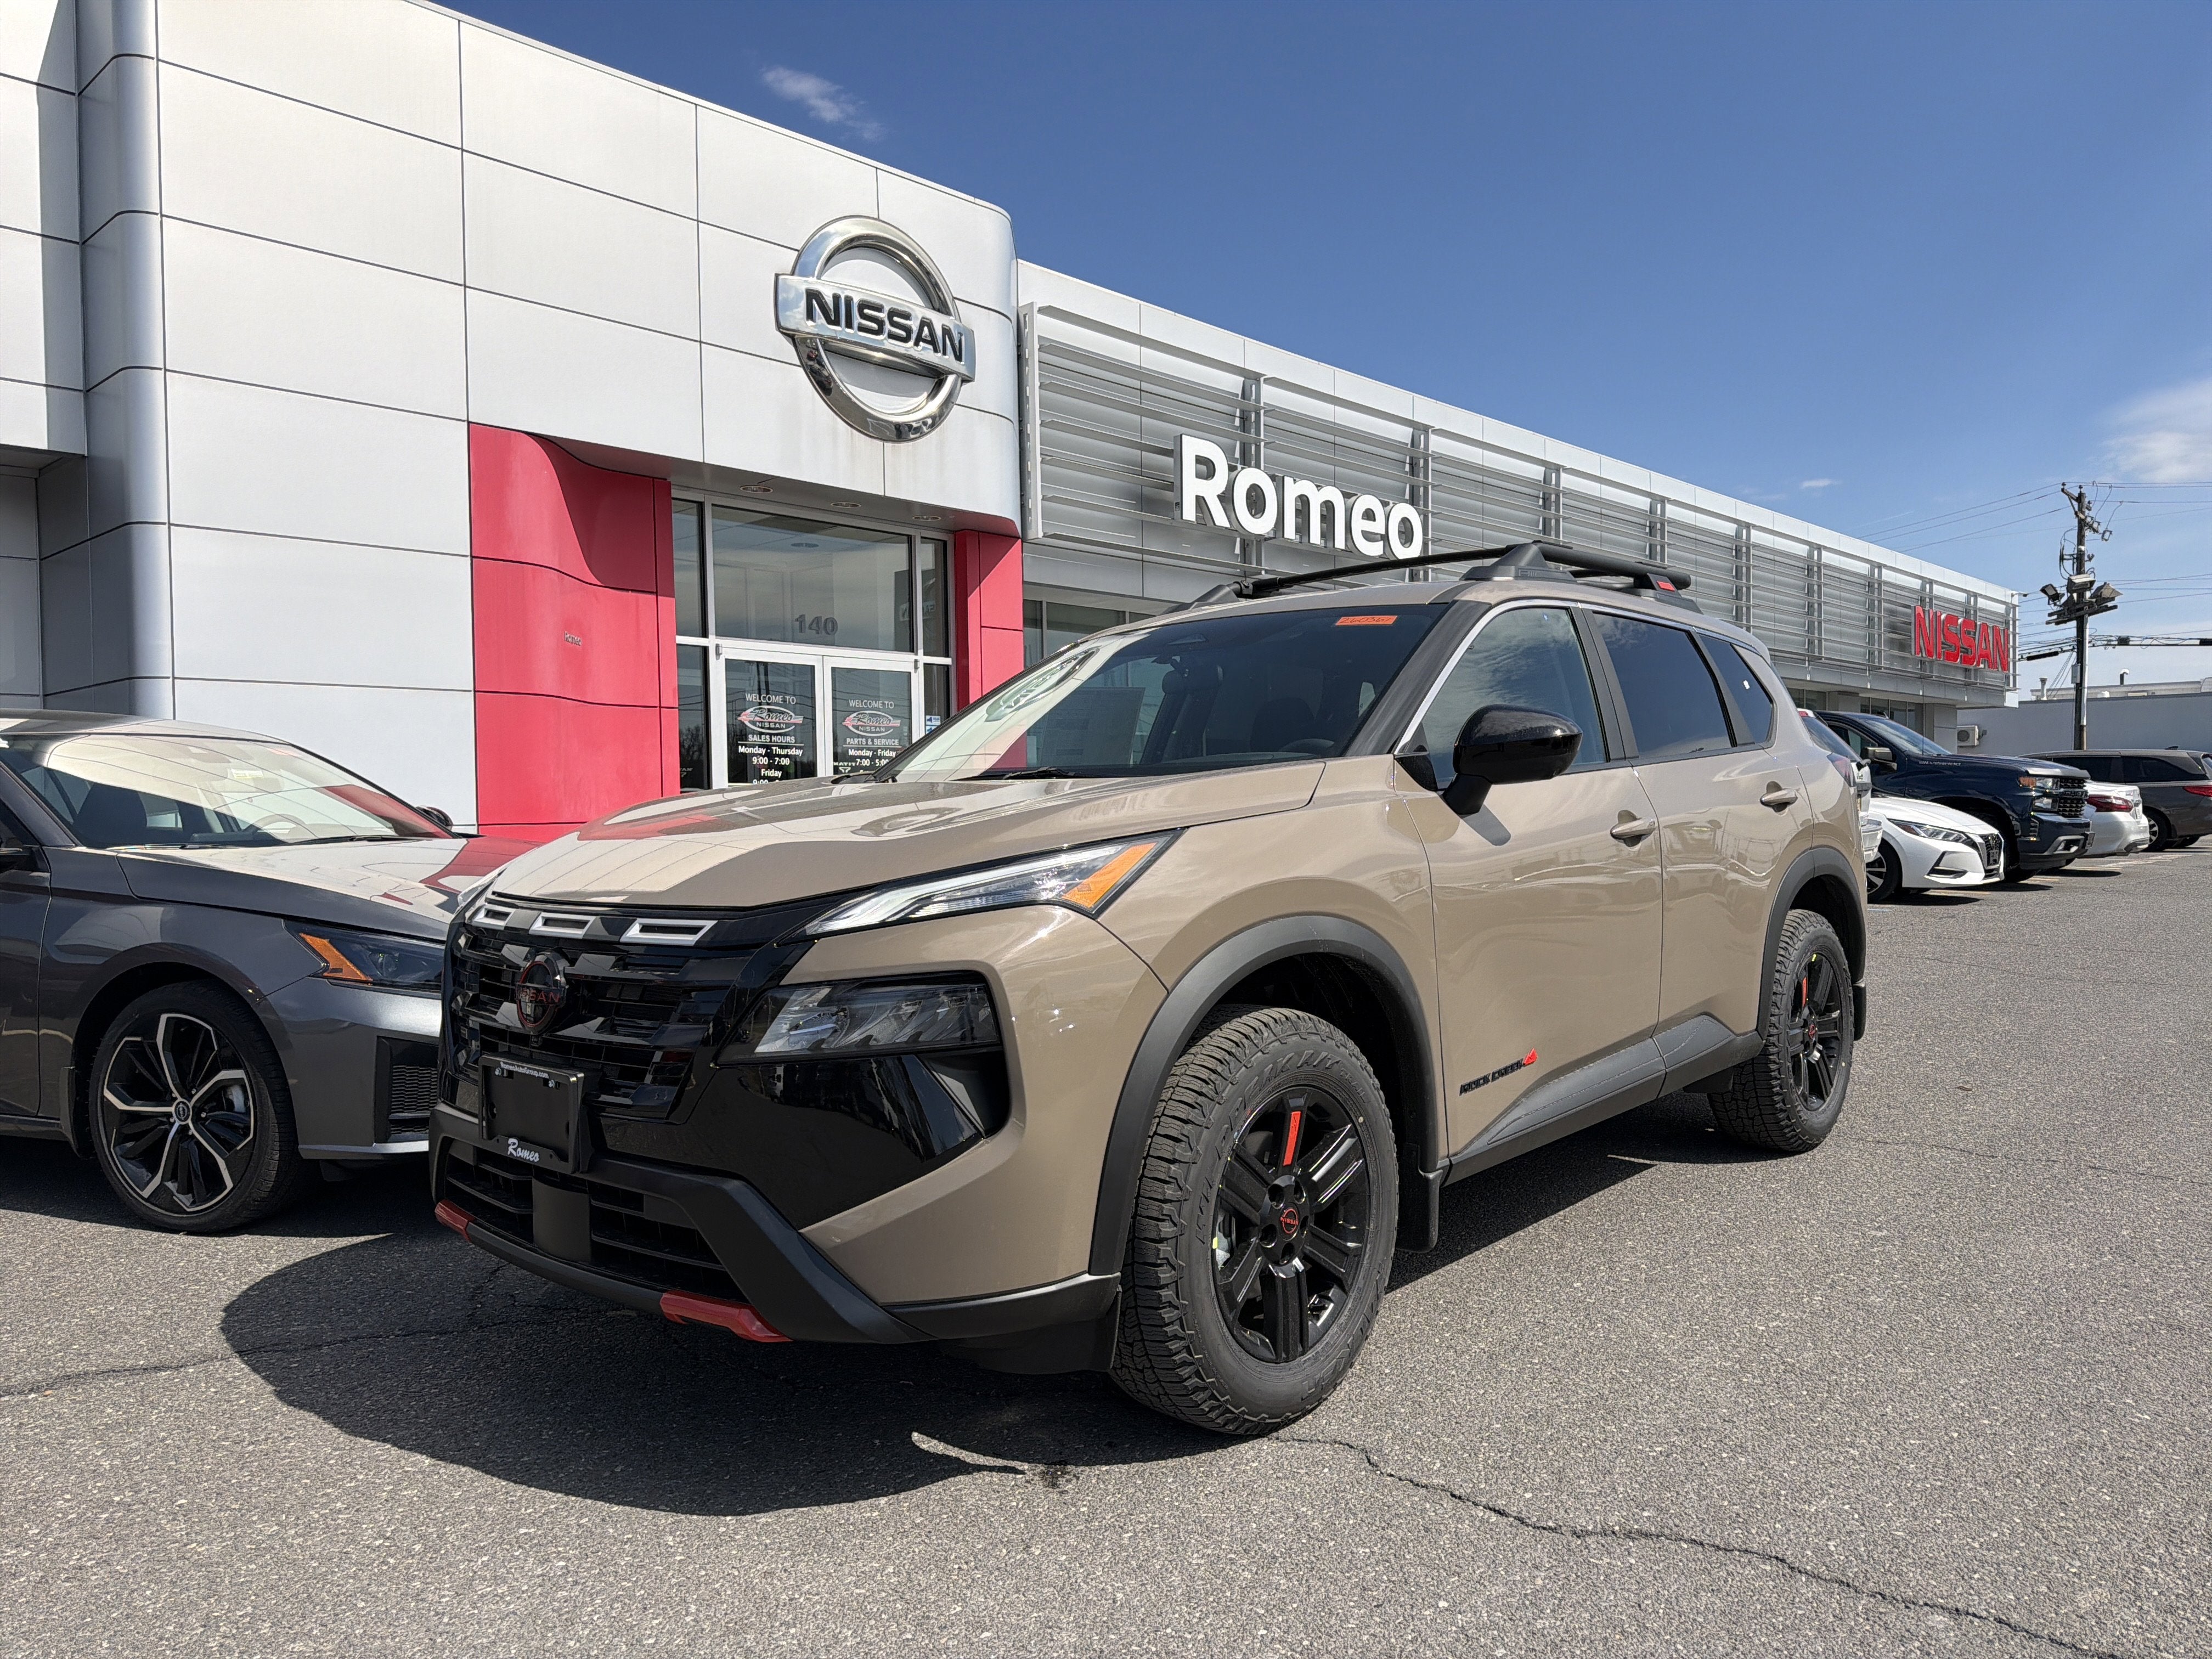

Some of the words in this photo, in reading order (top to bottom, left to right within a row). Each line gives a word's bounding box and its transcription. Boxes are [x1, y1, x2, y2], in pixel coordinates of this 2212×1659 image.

[804, 288, 966, 364] NISSAN
[1174, 433, 1423, 560] Romeo
[795, 614, 838, 635] 140
[1912, 605, 2008, 673] NISSAN
[745, 693, 783, 703] WELCOME
[785, 696, 796, 704] TO
[849, 699, 883, 708] WELCOME
[884, 701, 894, 709] TO
[752, 707, 794, 721] Romeo
[853, 712, 891, 725] Romeo
[771, 735, 795, 743] HOURS
[738, 746, 766, 755] Monday
[771, 747, 803, 757] Thursday
[848, 748, 873, 758] Monday
[878, 749, 896, 758] Friday
[752, 757, 768, 765] 9:00
[774, 757, 790, 765] 7:00
[856, 758, 870, 766] 7:00
[761, 769, 782, 778] Friday
[518, 986, 561, 1003] SSAN
[500, 1061, 549, 1080] RomeoAutoGroup.com
[1459, 1073, 1491, 1096] ROCK
[1491, 1058, 1526, 1083] CREEK
[507, 1138, 540, 1163] Romeo
[1280, 1216, 1299, 1226] NISSAN
